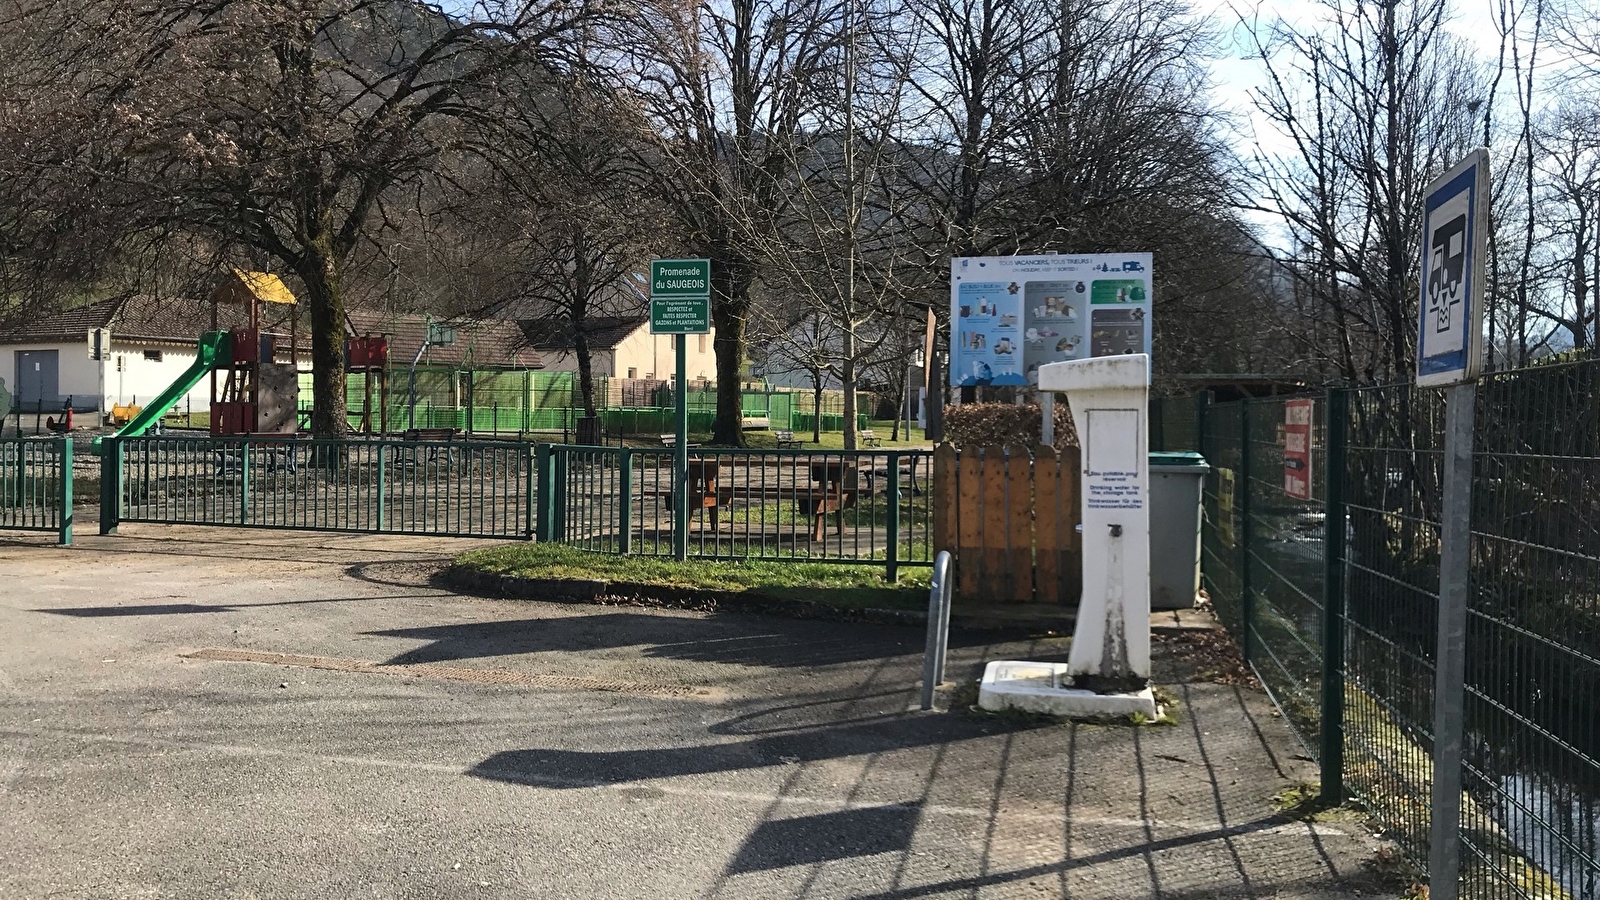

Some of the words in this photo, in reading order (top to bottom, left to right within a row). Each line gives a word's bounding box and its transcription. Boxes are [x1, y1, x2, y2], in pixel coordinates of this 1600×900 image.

[660, 267, 700, 276] Promenade
[655, 280, 665, 289] du
[666, 279, 704, 289] SAUGEOIS
